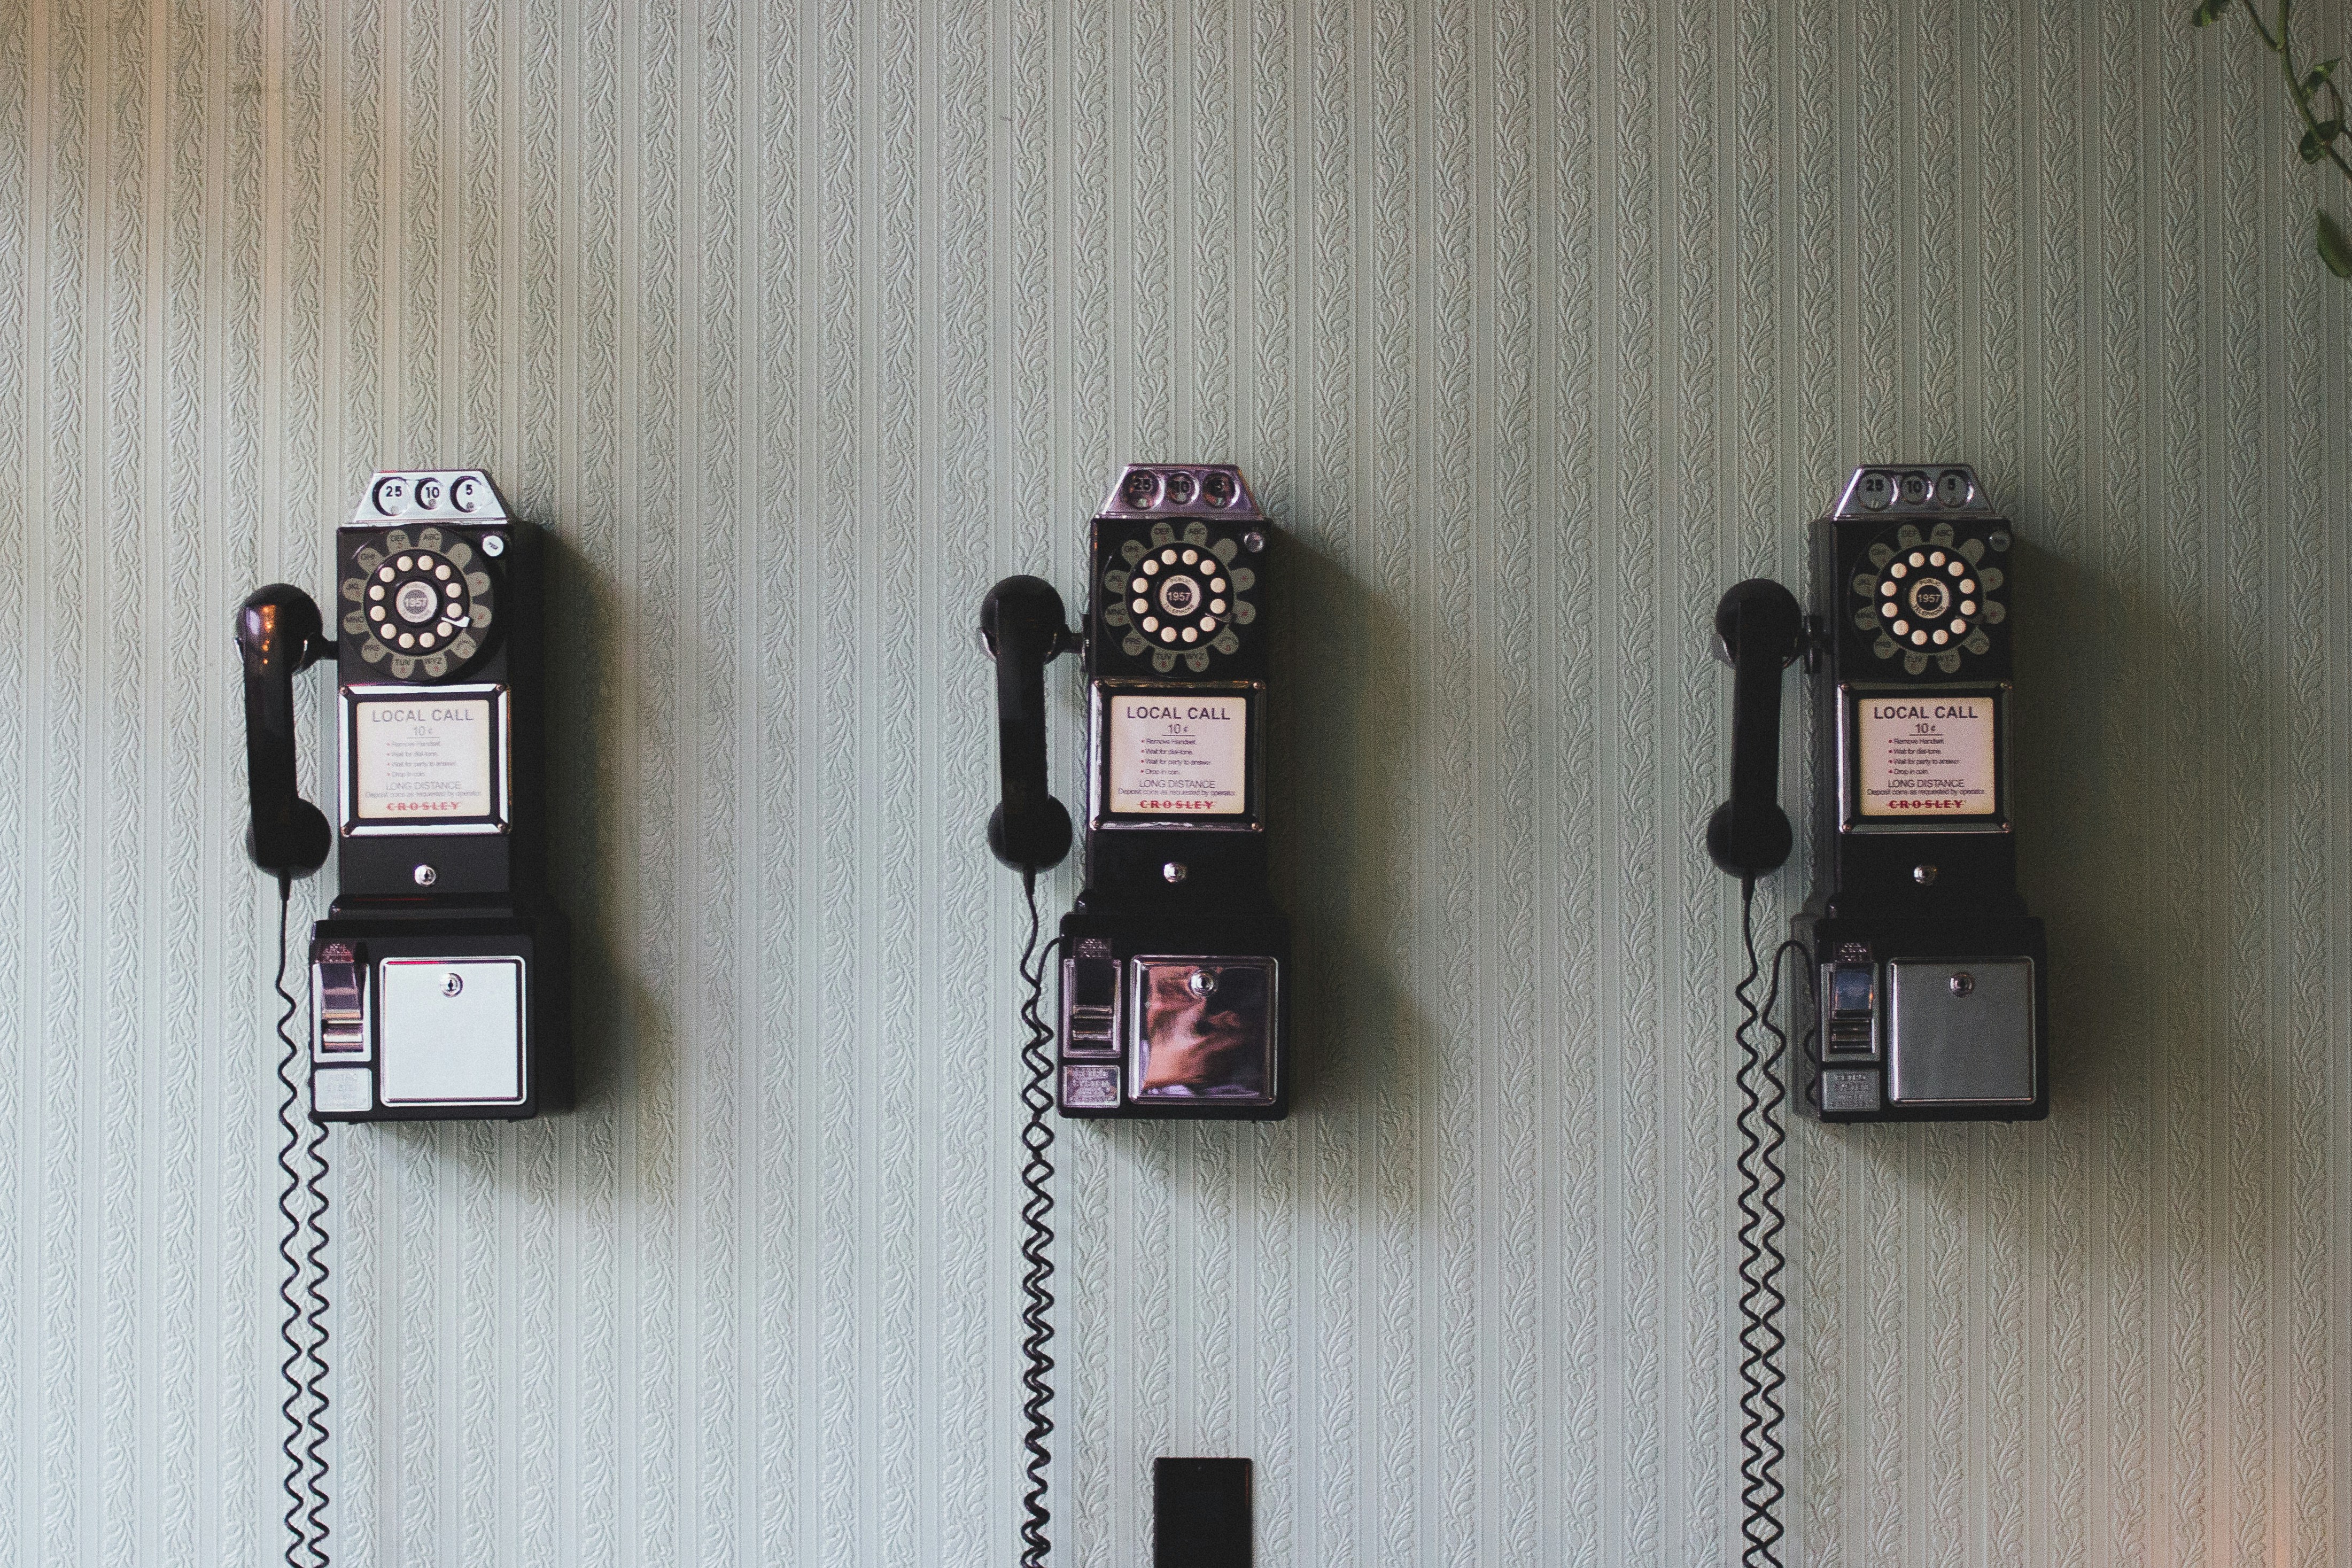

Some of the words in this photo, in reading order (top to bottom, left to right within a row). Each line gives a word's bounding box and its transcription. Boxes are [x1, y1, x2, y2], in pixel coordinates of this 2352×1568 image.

[1134, 478, 1152, 491] 25
[1175, 480, 1190, 493] 10
[1866, 479, 1884, 491] 25
[1907, 481, 1922, 493] 10
[1947, 478, 1955, 491] 5
[385, 486, 402, 497] 25
[425, 487, 440, 499] 10
[465, 484, 472, 495] 5
[1167, 592, 1191, 601] 1957
[1918, 594, 1941, 603] 1957
[404, 598, 428, 607] 1957
[372, 709, 426, 723] LOCAL
[432, 709, 474, 721] CALL
[1127, 707, 1182, 719] LOCAL
[1187, 707, 1230, 720] CALL
[1874, 707, 1929, 719] LOCAL
[1935, 706, 1978, 718] CALL
[413, 726, 425, 736] 10
[1168, 724, 1181, 734] 10
[1915, 723, 1928, 733] 10
[386, 782, 412, 790] LONG
[414, 781, 461, 790] DISTANCE
[1139, 780, 1166, 788] LONG
[1168, 780, 1215, 788] DISTANCE
[1888, 779, 1915, 788] LONG
[1917, 779, 1965, 787] DISTANCE
[386, 802, 461, 811] CROSLEY
[1139, 800, 1215, 809] CROSLEY
[1888, 800, 1963, 809] CROSLEY
